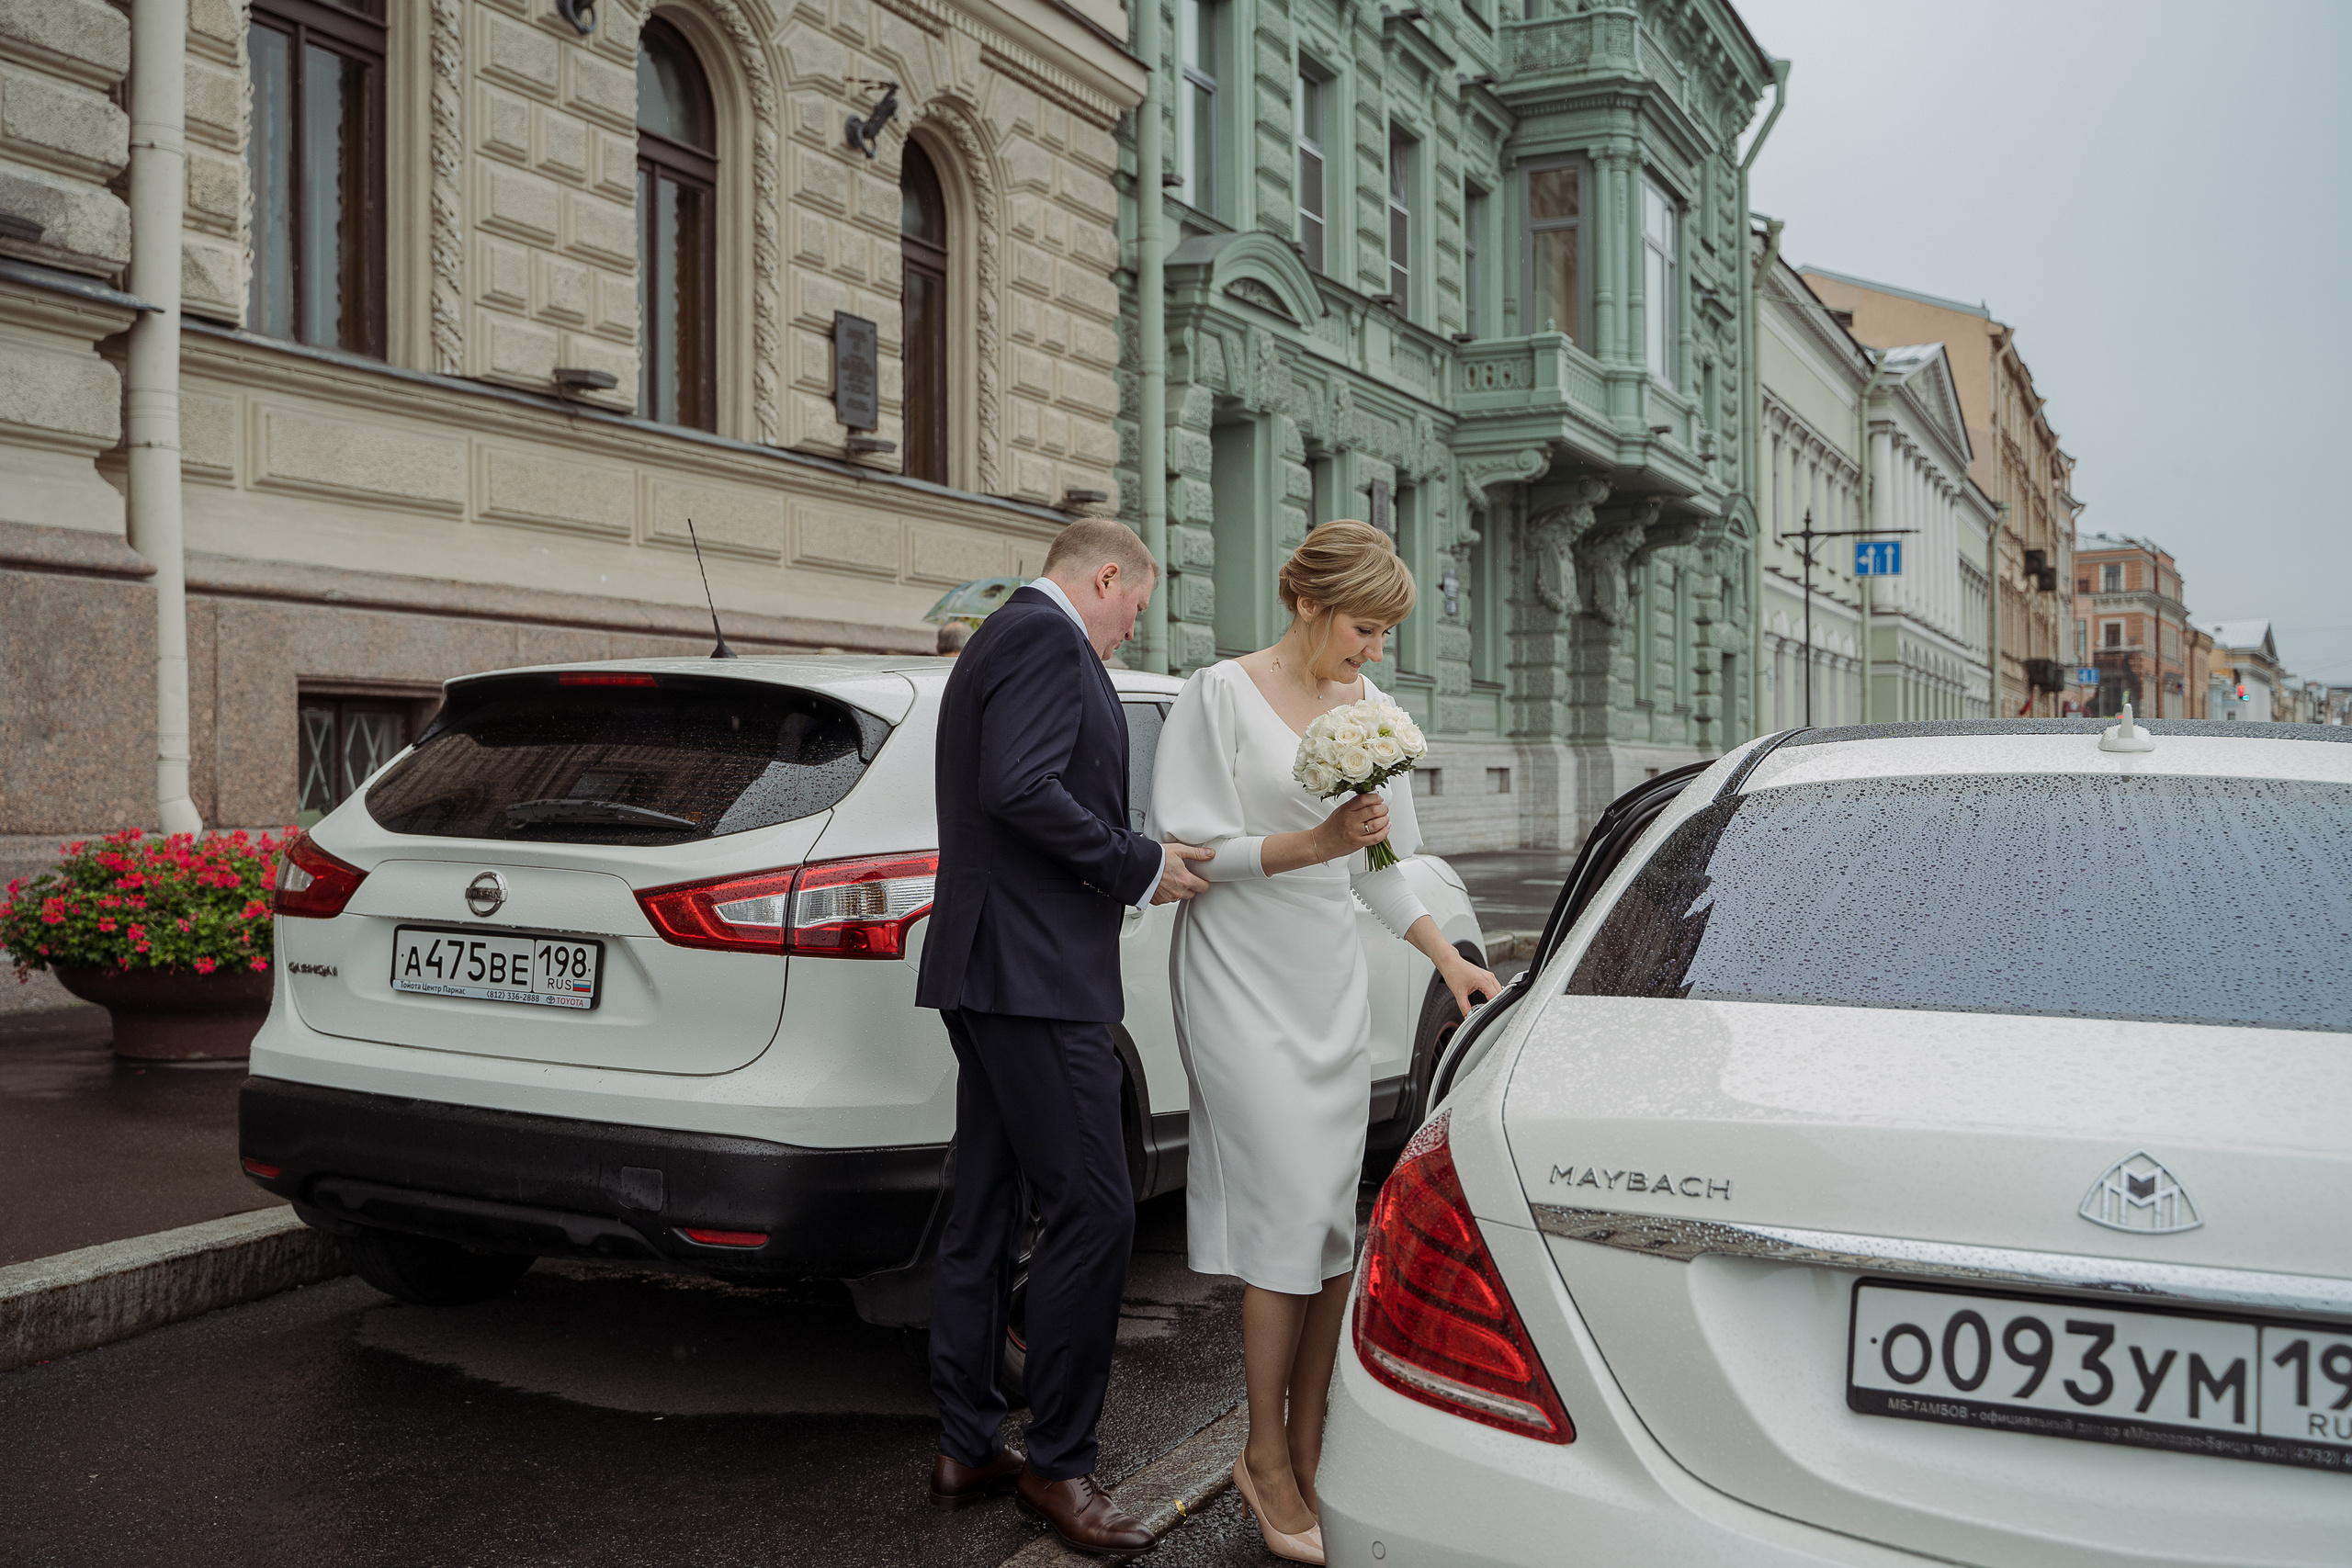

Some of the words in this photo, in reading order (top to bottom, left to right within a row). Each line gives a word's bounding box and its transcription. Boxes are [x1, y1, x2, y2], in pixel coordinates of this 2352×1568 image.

[404, 939, 529, 986] А475ВЕ
[537, 944, 587, 978] 198
[401, 980, 421, 990] Тойота
[423, 983, 442, 994] Центр
[548, 978, 571, 990] RUS
[487, 990, 505, 999] (812)
[507, 992, 540, 1002] 336-2888
[557, 997, 584, 1007] TOYOTA
[1550, 1164, 1733, 1200] MAYBACH
[1887, 1397, 1969, 1418] МБ-ТАМБОВ
